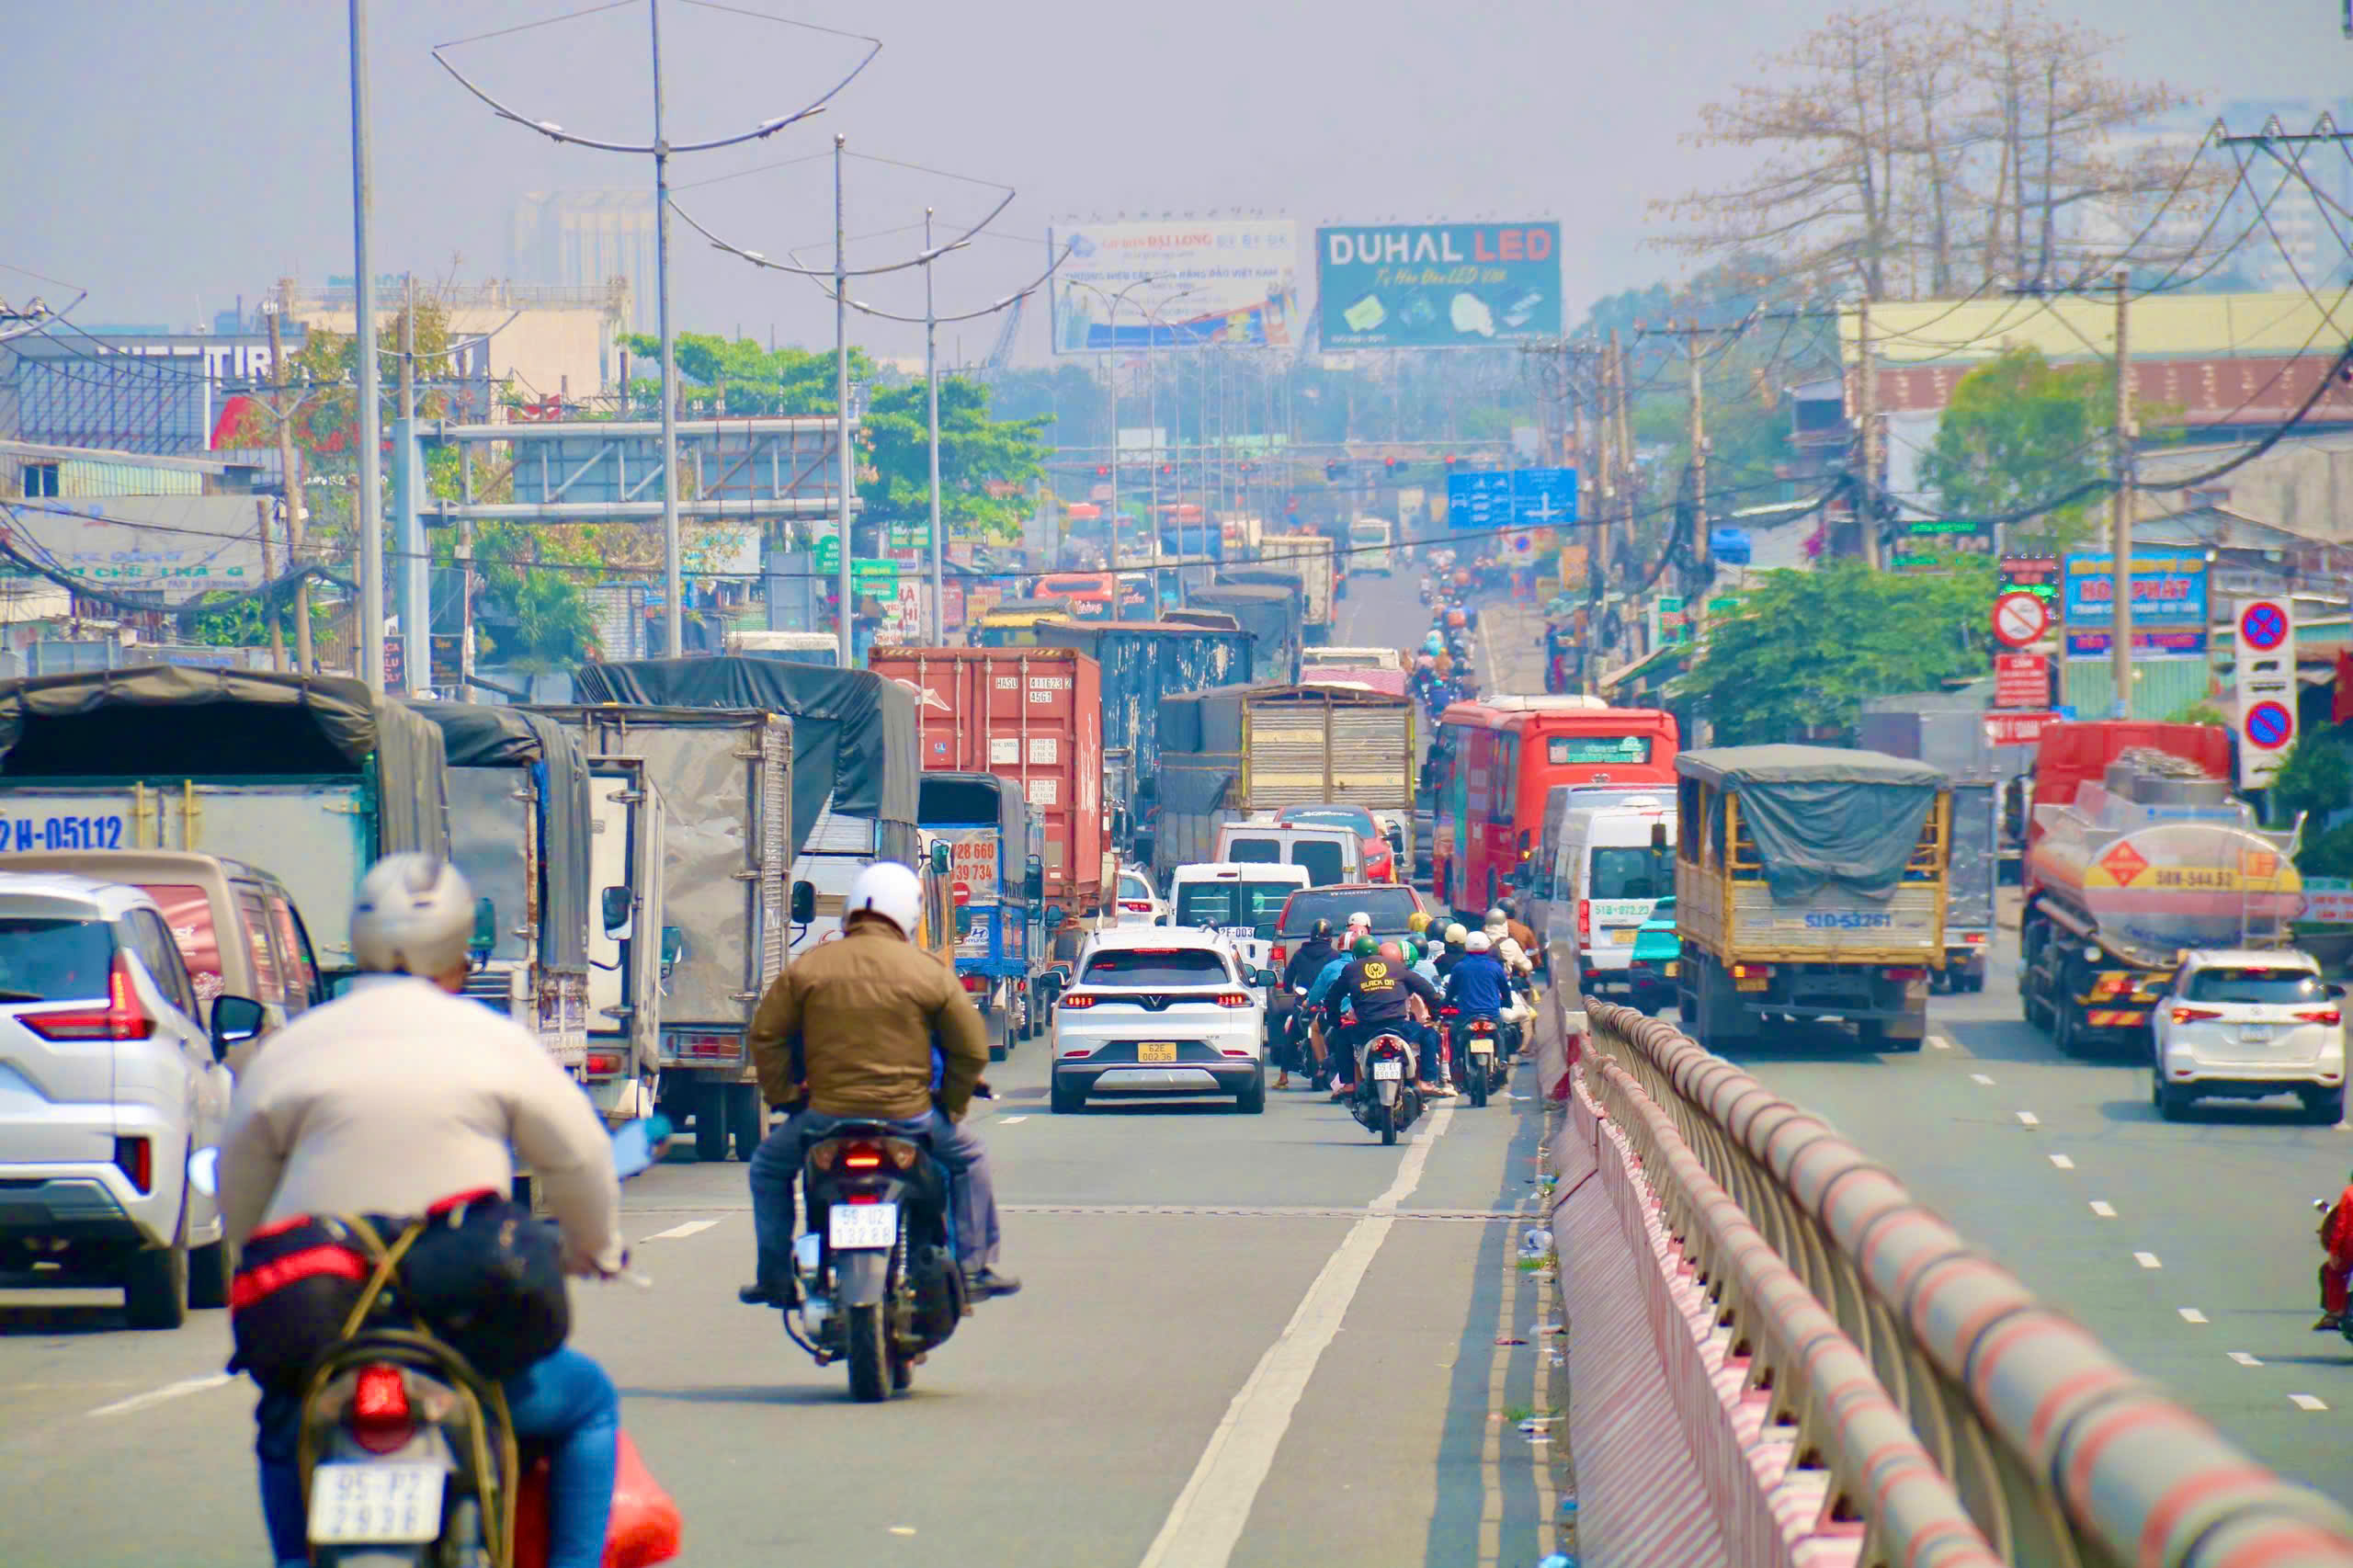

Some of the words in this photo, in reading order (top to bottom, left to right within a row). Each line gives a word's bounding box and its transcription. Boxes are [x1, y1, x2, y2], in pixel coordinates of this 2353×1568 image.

[1329, 232, 1464, 265] DUHAL
[1473, 229, 1552, 262] LED
[996, 678, 1018, 688] HASU
[974, 844, 994, 859] 660
[972, 865, 993, 881] 734
[1149, 1043, 1165, 1052] 62E
